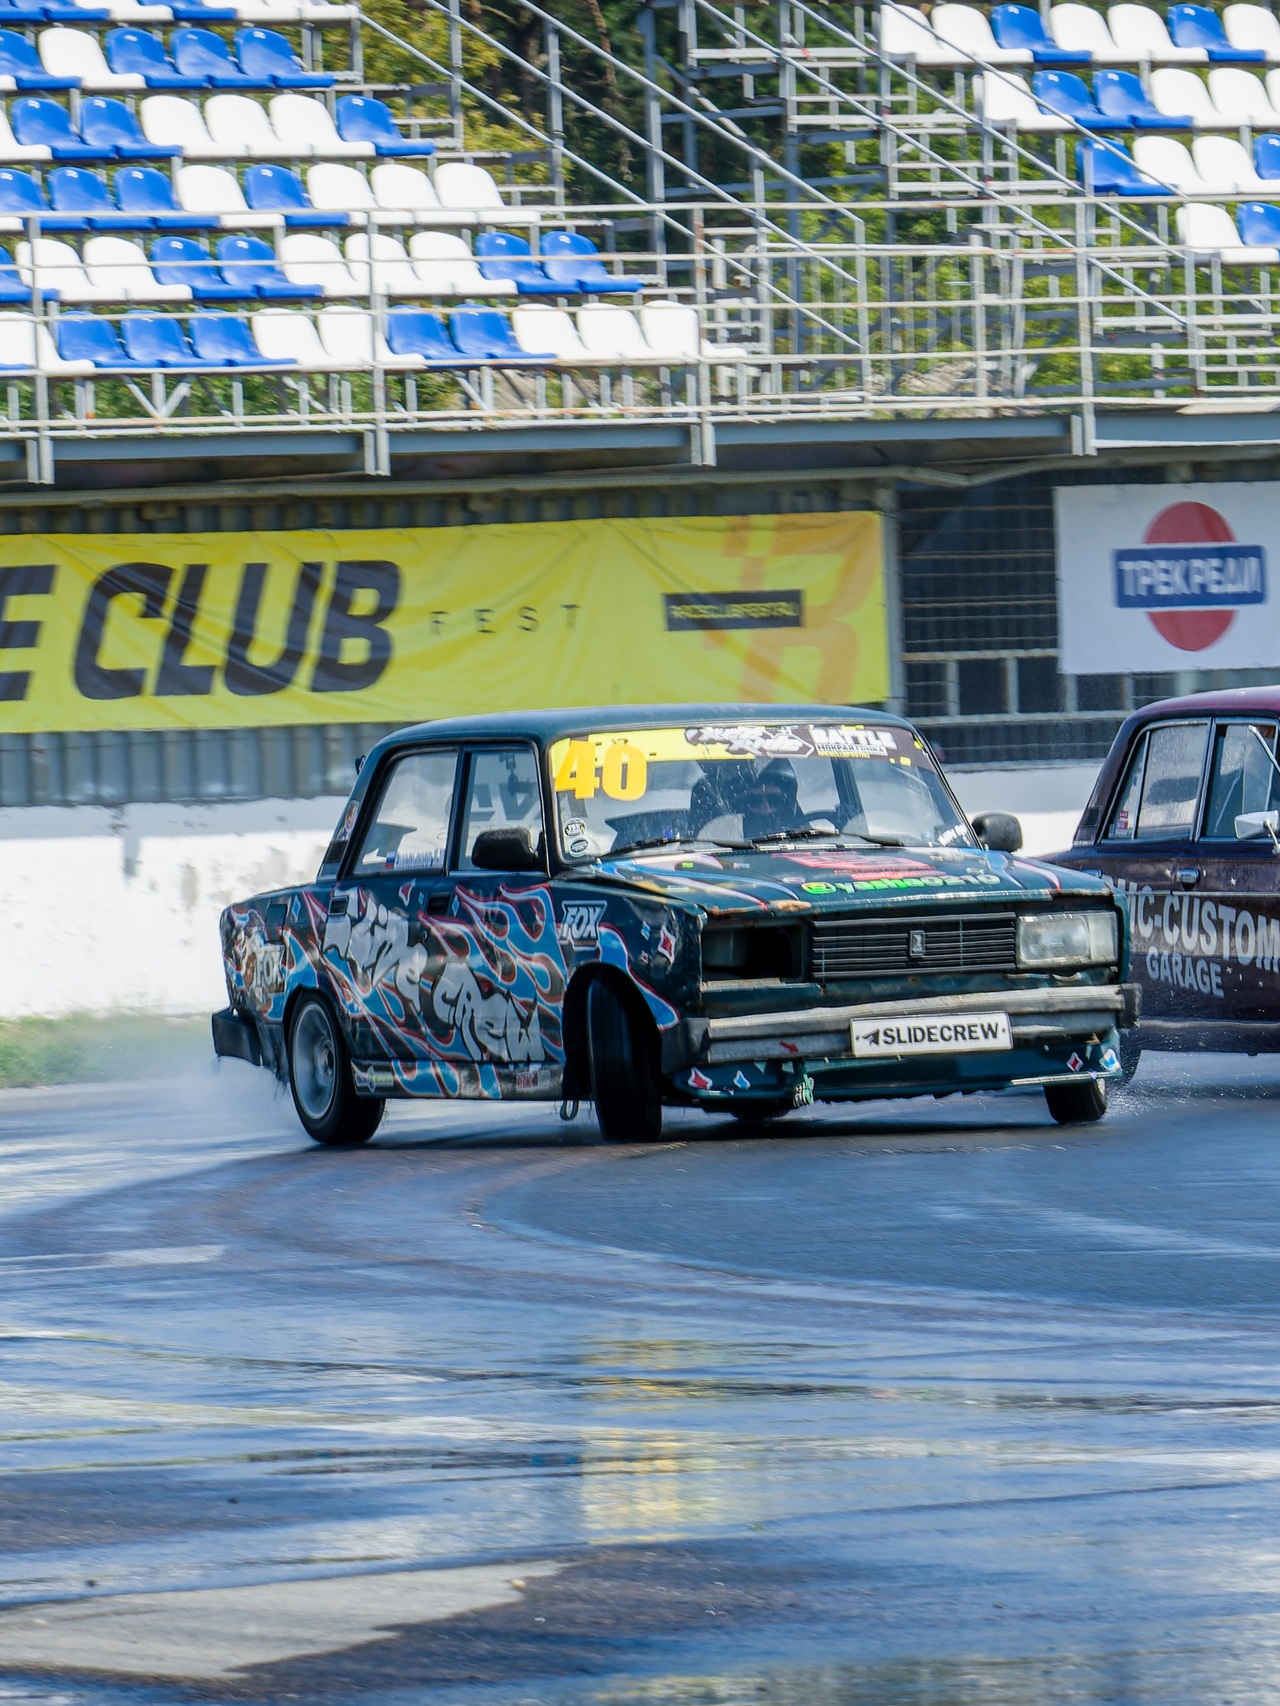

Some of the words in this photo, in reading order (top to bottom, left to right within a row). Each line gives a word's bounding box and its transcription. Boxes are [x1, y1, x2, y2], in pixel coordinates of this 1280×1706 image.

[74, 560, 402, 700] CLUB
[428, 603, 582, 636] FEST
[808, 728, 898, 750] BATTLE
[554, 740, 648, 801] 40
[560, 905, 600, 937] FOX
[254, 951, 284, 988] FOX
[1147, 945, 1225, 998] GARAGE
[883, 1022, 999, 1045] SLIDECREW
